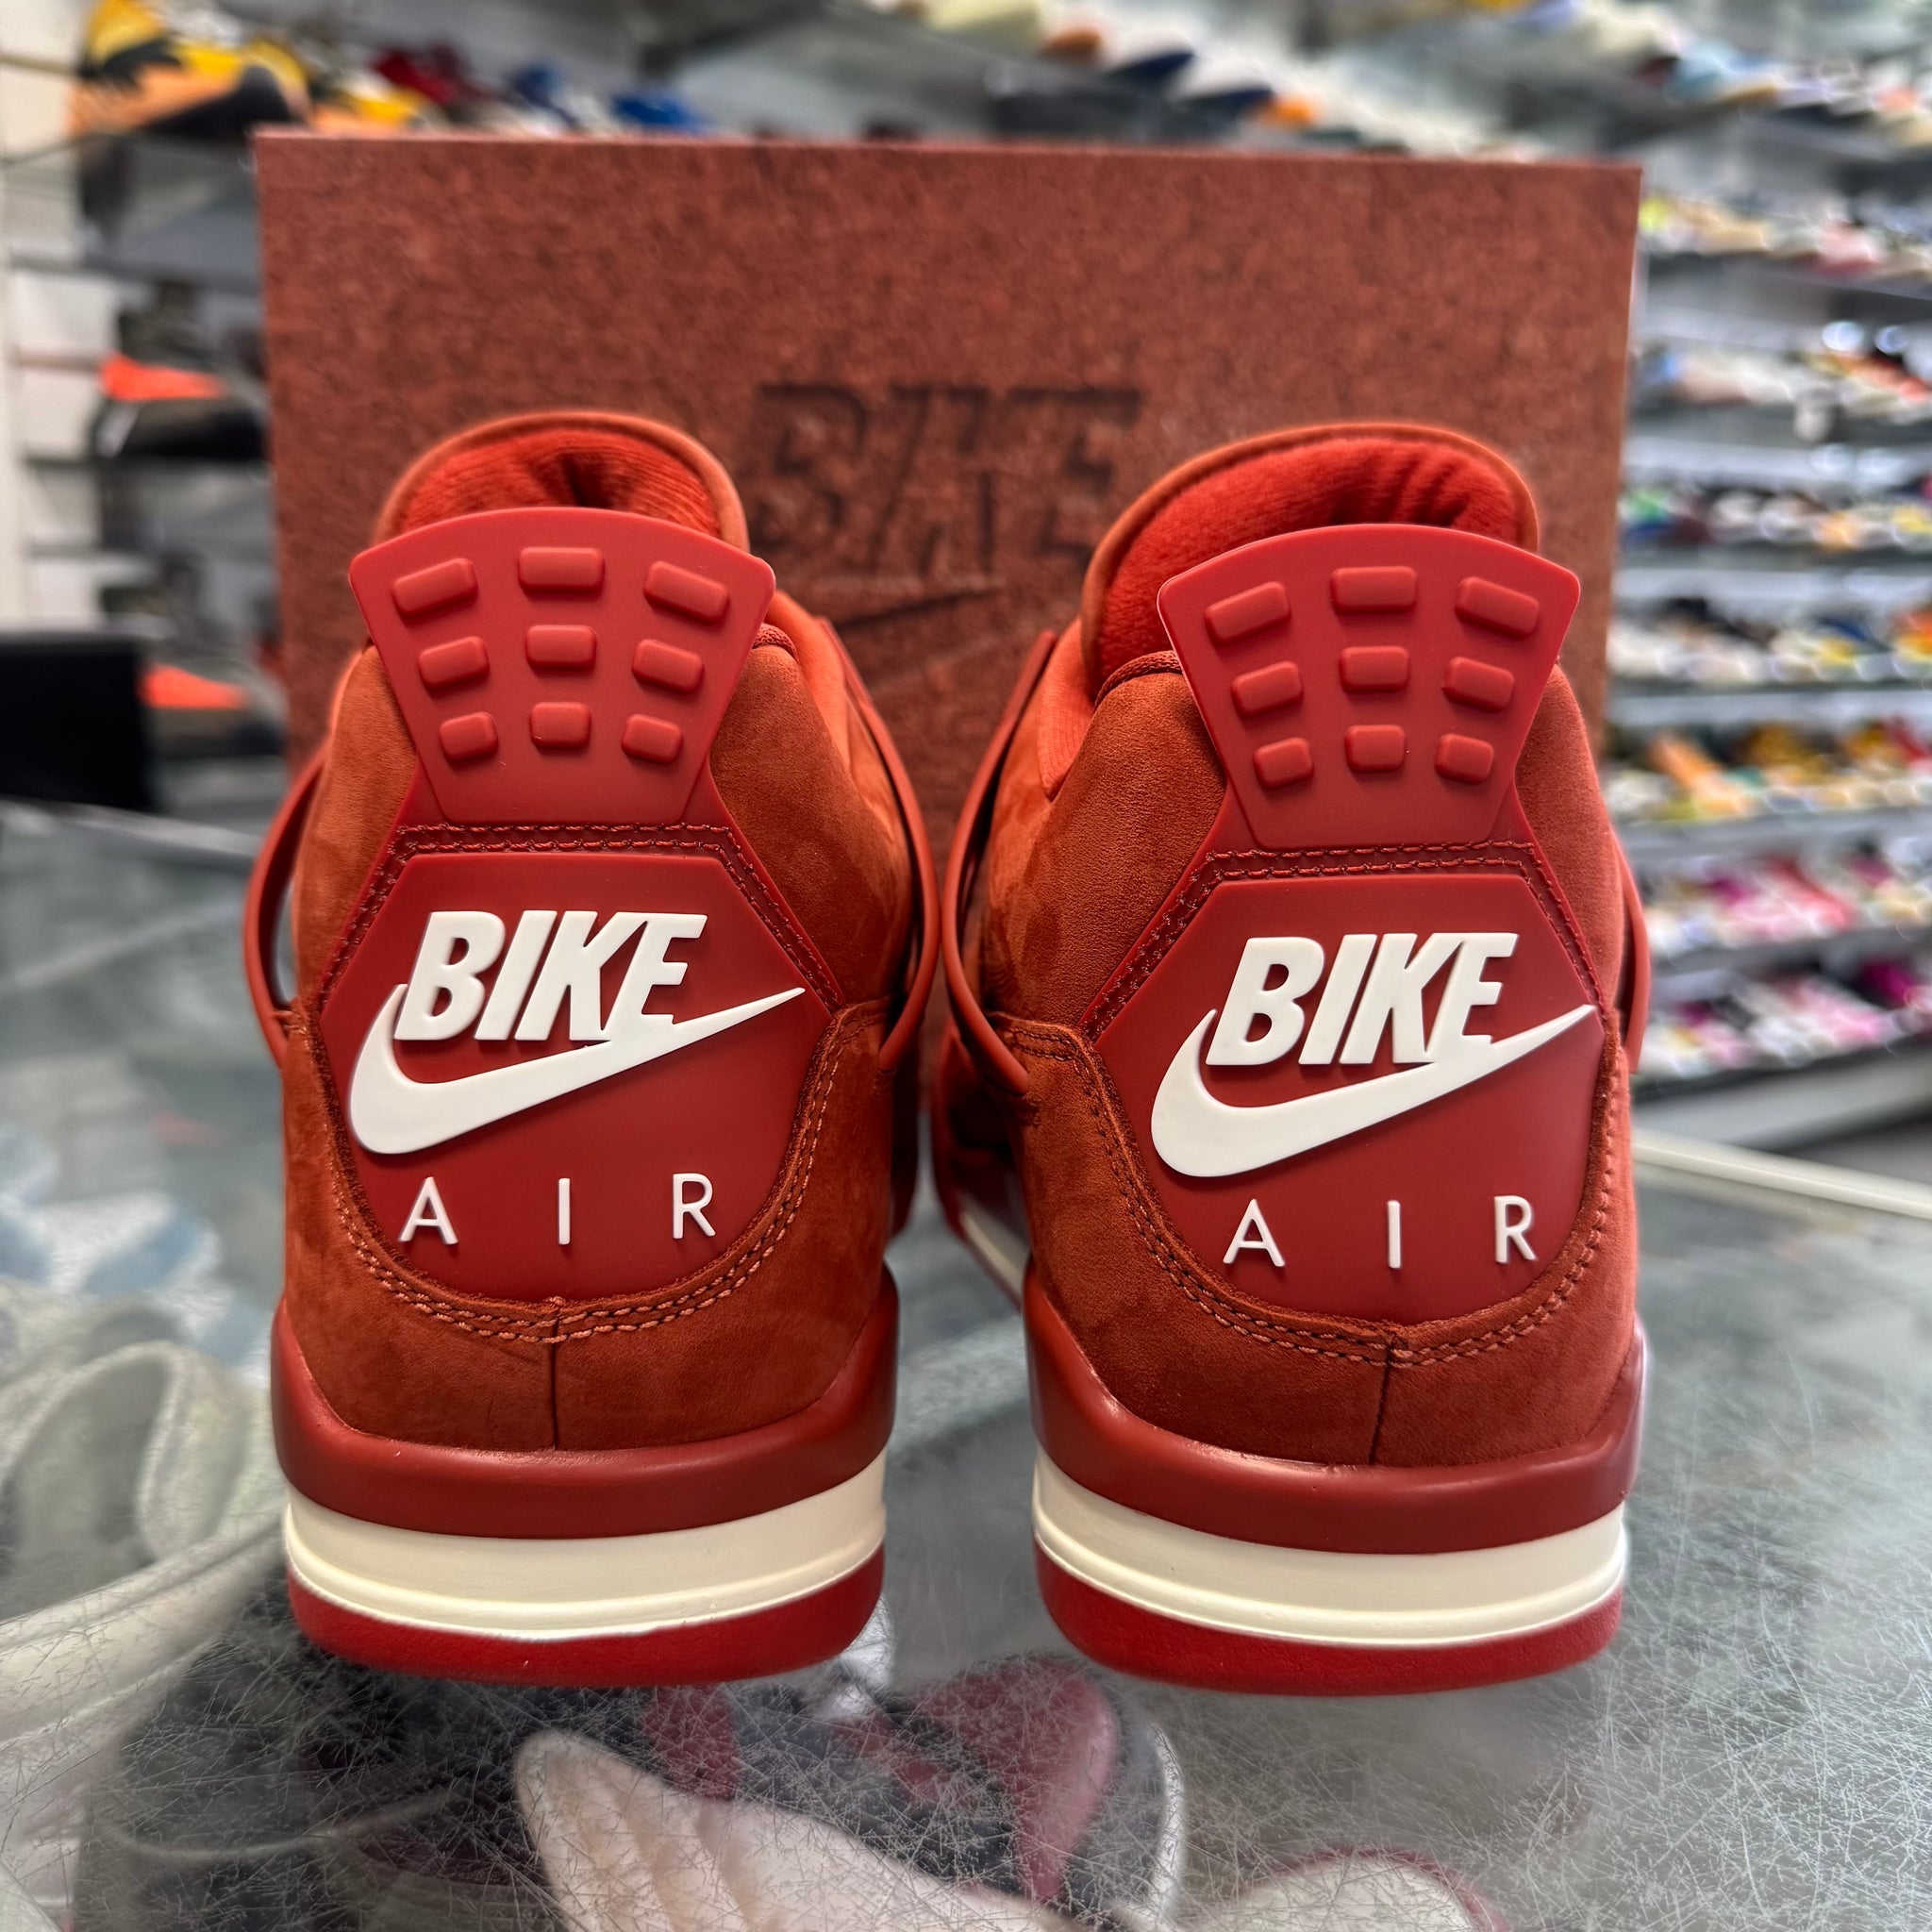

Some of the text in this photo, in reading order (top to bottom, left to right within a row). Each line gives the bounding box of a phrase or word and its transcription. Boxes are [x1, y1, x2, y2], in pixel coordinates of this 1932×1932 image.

[393, 909, 708, 1041] BIKE
[1205, 932, 1519, 1066] BIKE
[398, 1173, 717, 1245] AIR
[1222, 1195, 1538, 1269] AIR
